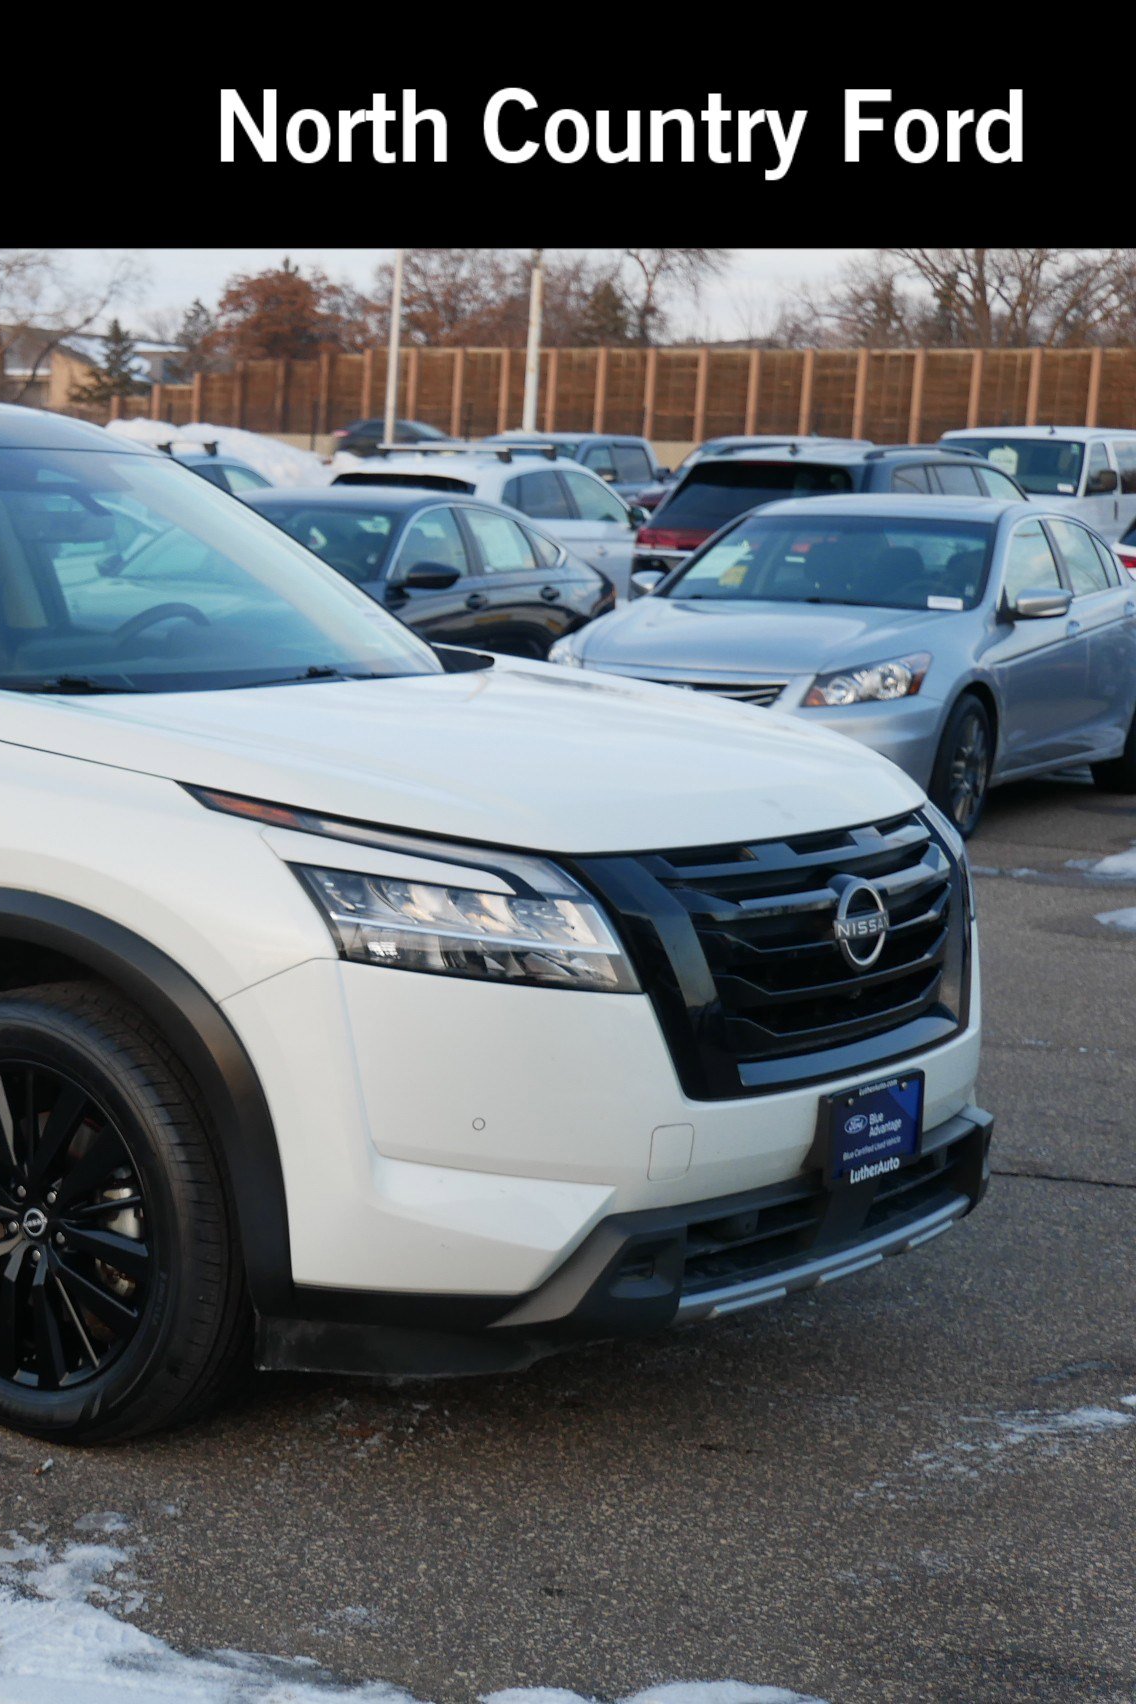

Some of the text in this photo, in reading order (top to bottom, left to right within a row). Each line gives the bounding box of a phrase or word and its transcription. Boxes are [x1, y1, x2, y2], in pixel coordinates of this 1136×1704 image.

[837, 916, 890, 937] NISSAN
[869, 1112, 884, 1126] Blue
[869, 1118, 902, 1138] Advantage
[849, 1156, 900, 1184] LutherAuto
